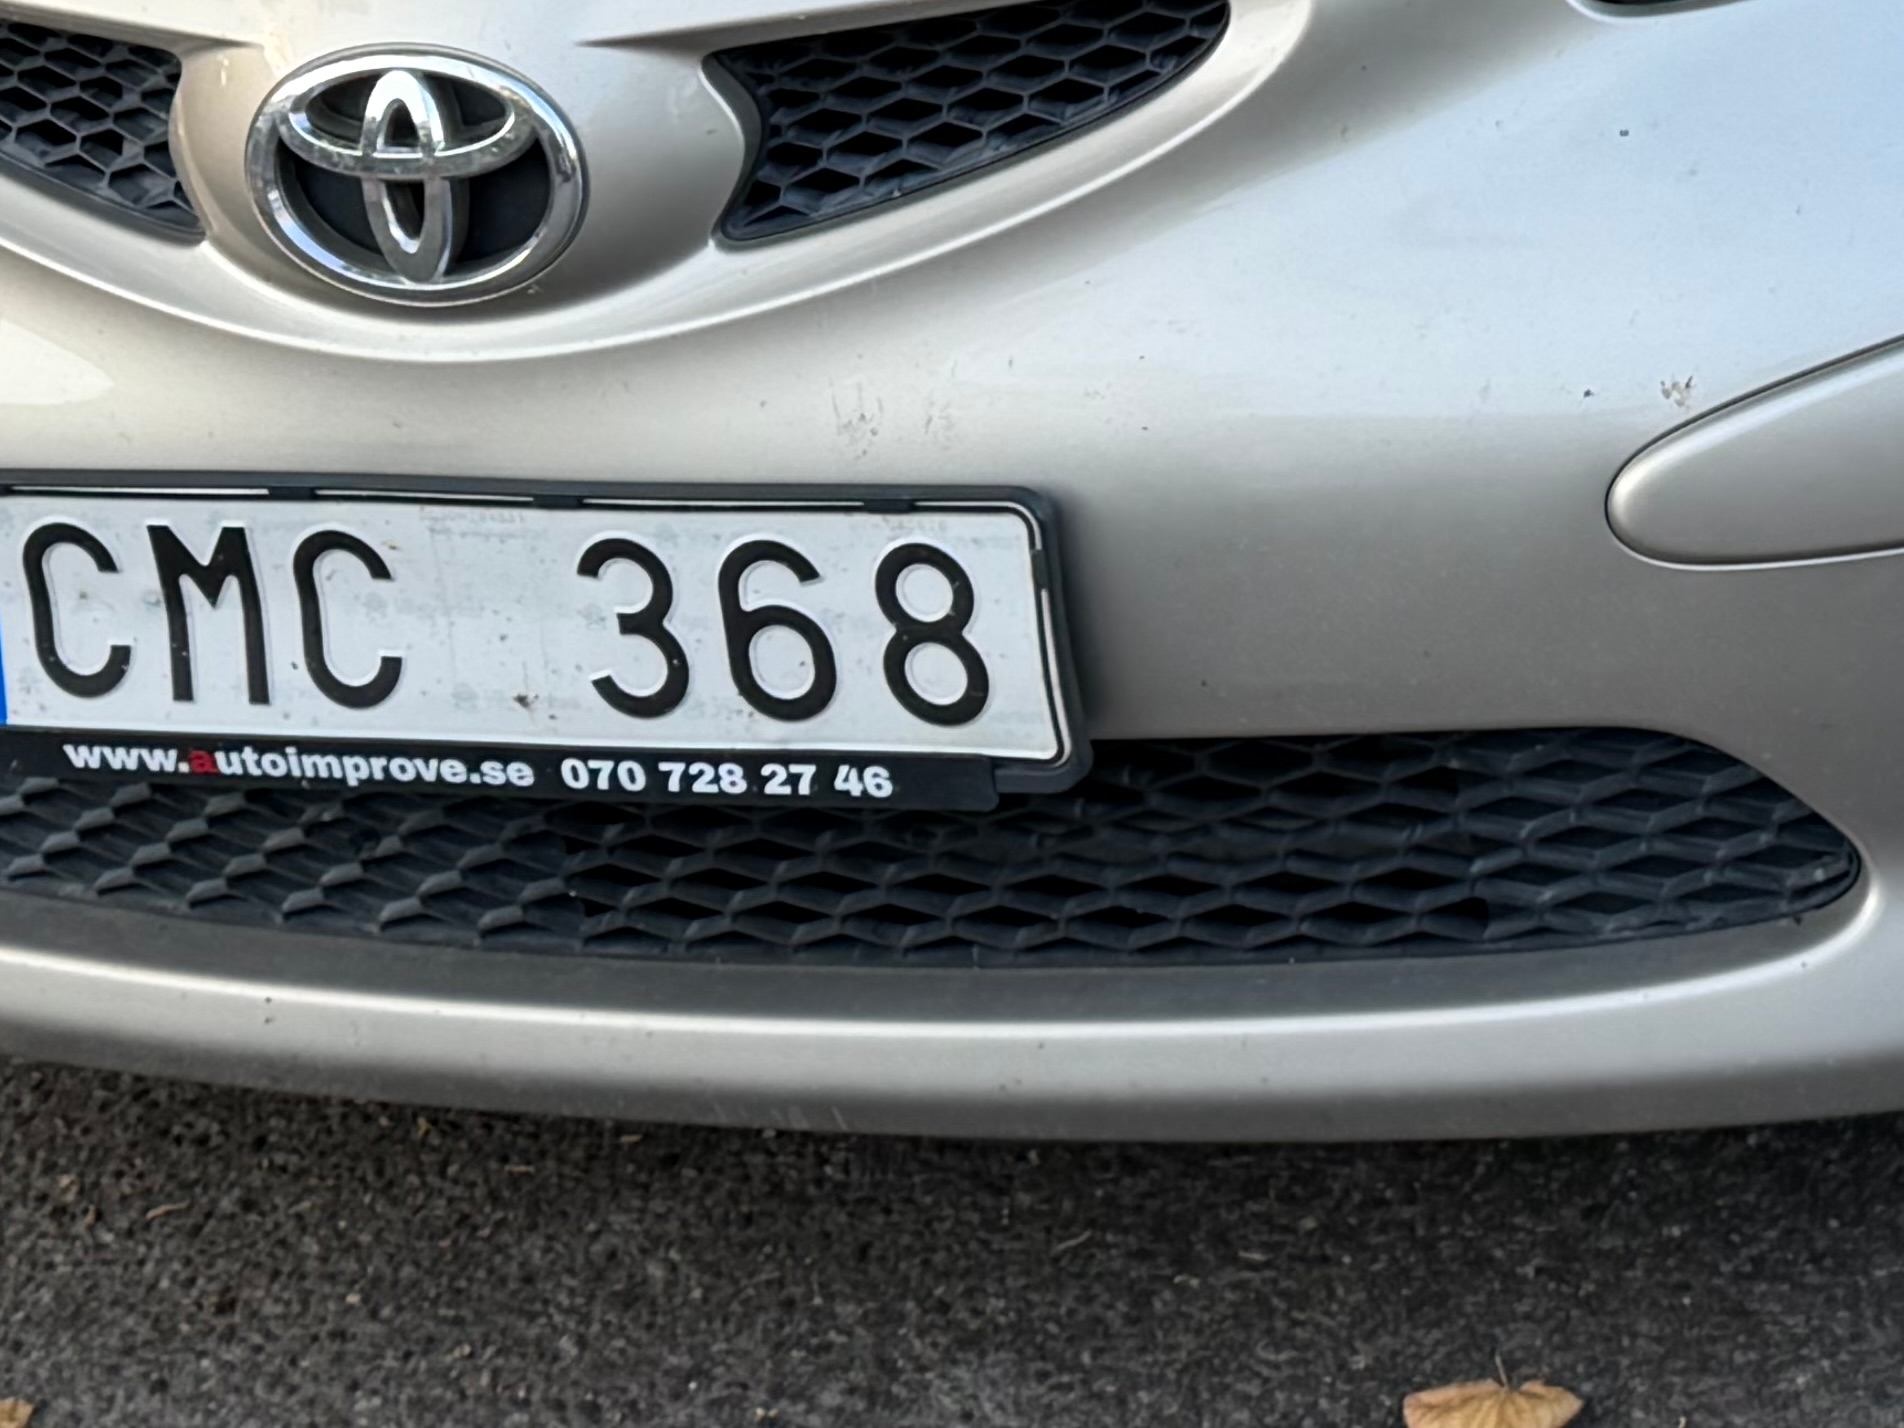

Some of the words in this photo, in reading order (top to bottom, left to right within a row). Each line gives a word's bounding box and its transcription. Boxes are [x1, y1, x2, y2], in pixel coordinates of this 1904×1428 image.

[22, 521, 404, 710] CMC
[575, 537, 991, 728] 368
[62, 744, 535, 787] www.autoimprove.se
[560, 758, 647, 792] 070
[658, 761, 748, 794] 728
[760, 763, 817, 796] 27
[833, 764, 894, 799] 46
